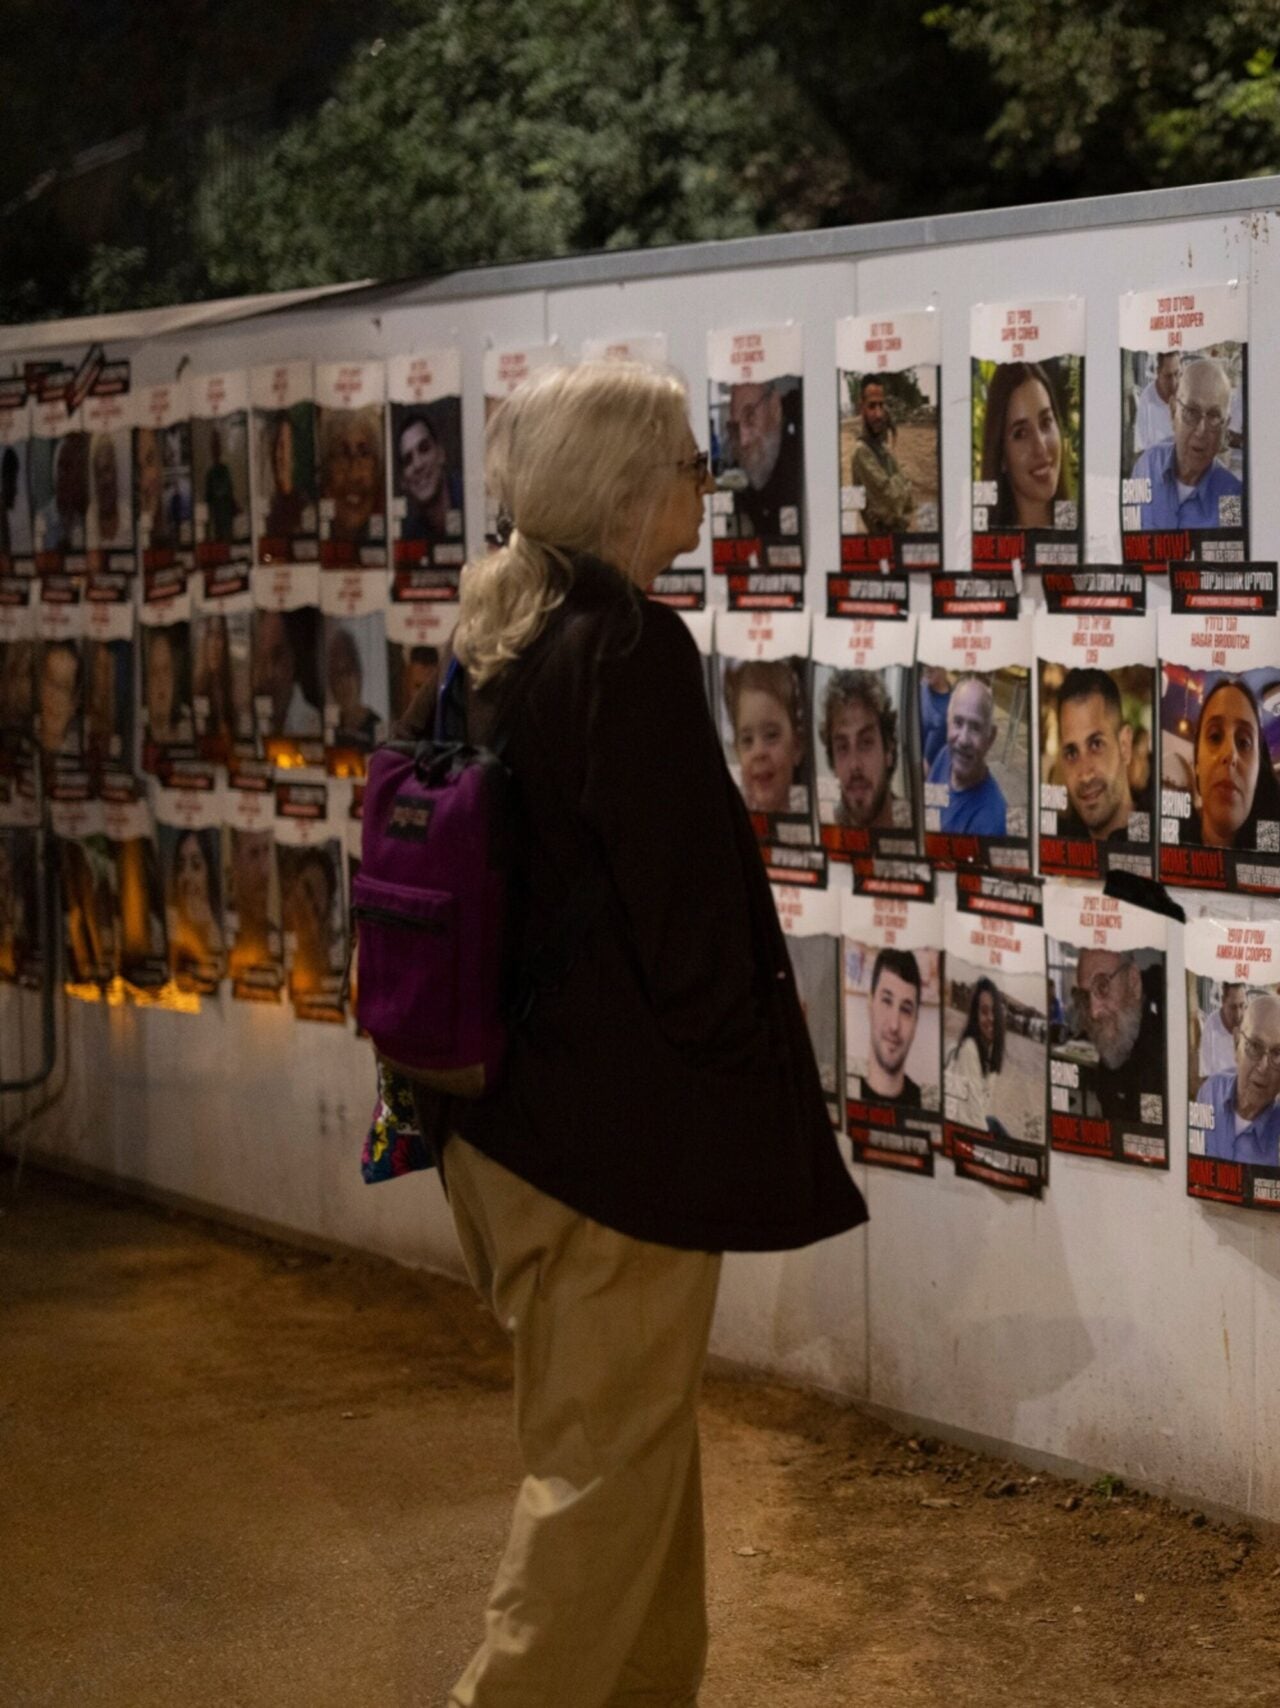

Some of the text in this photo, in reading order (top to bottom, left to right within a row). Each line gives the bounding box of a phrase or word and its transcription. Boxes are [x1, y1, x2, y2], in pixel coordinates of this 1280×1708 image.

[1122, 478, 1152, 504] BRING
[1162, 789, 1191, 818] BRING
[1245, 947, 1272, 963] COOPER
[1189, 1101, 1215, 1130] BRING
